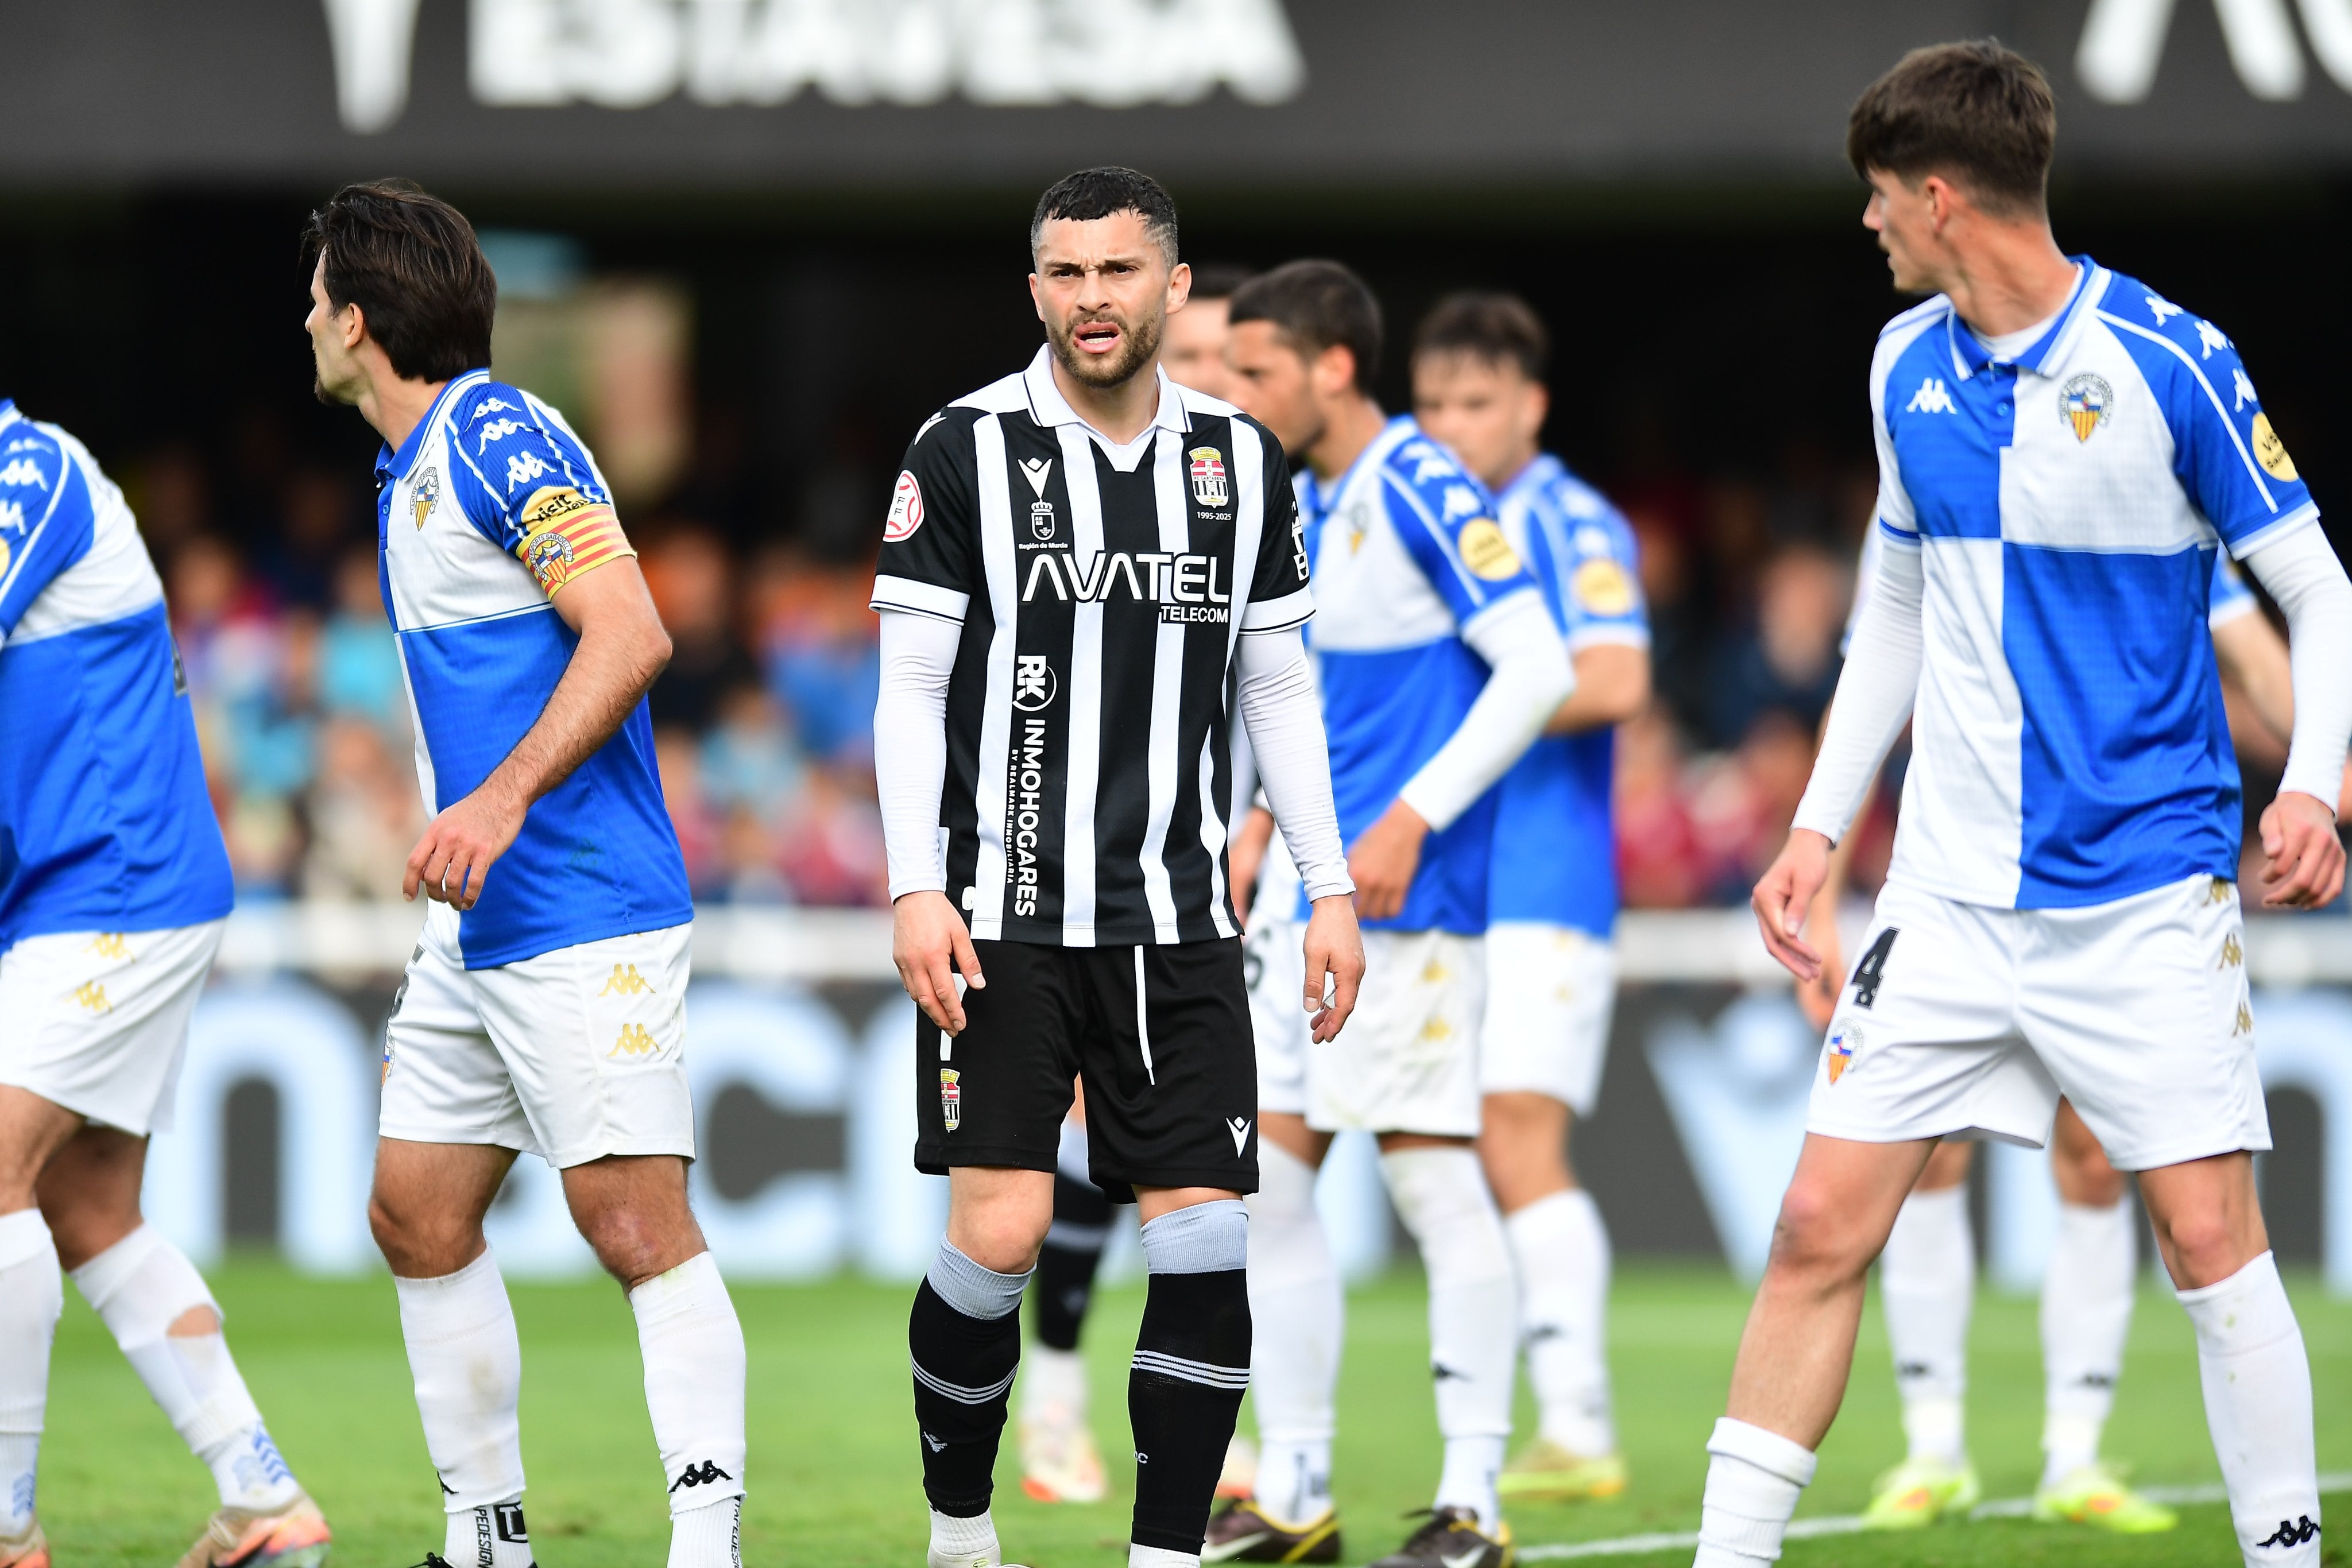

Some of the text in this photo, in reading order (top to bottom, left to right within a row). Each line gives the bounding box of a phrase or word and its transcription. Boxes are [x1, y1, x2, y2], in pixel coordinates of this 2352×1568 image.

[532, 494, 572, 522] visit
[1197, 512, 1232, 520] 1995-2025
[546, 534, 570, 549] SABADELL
[1022, 552, 1230, 603] AVATEL
[1160, 606, 1228, 624] TELECOM
[1016, 655, 1047, 701] RK
[1005, 749, 1019, 884] BY REALMARK INMOBILIARIA
[1015, 719, 1046, 917] INMOHOGARES
[1850, 926, 1900, 1011] 4
[474, 1505, 493, 1568] PEDESIGN
